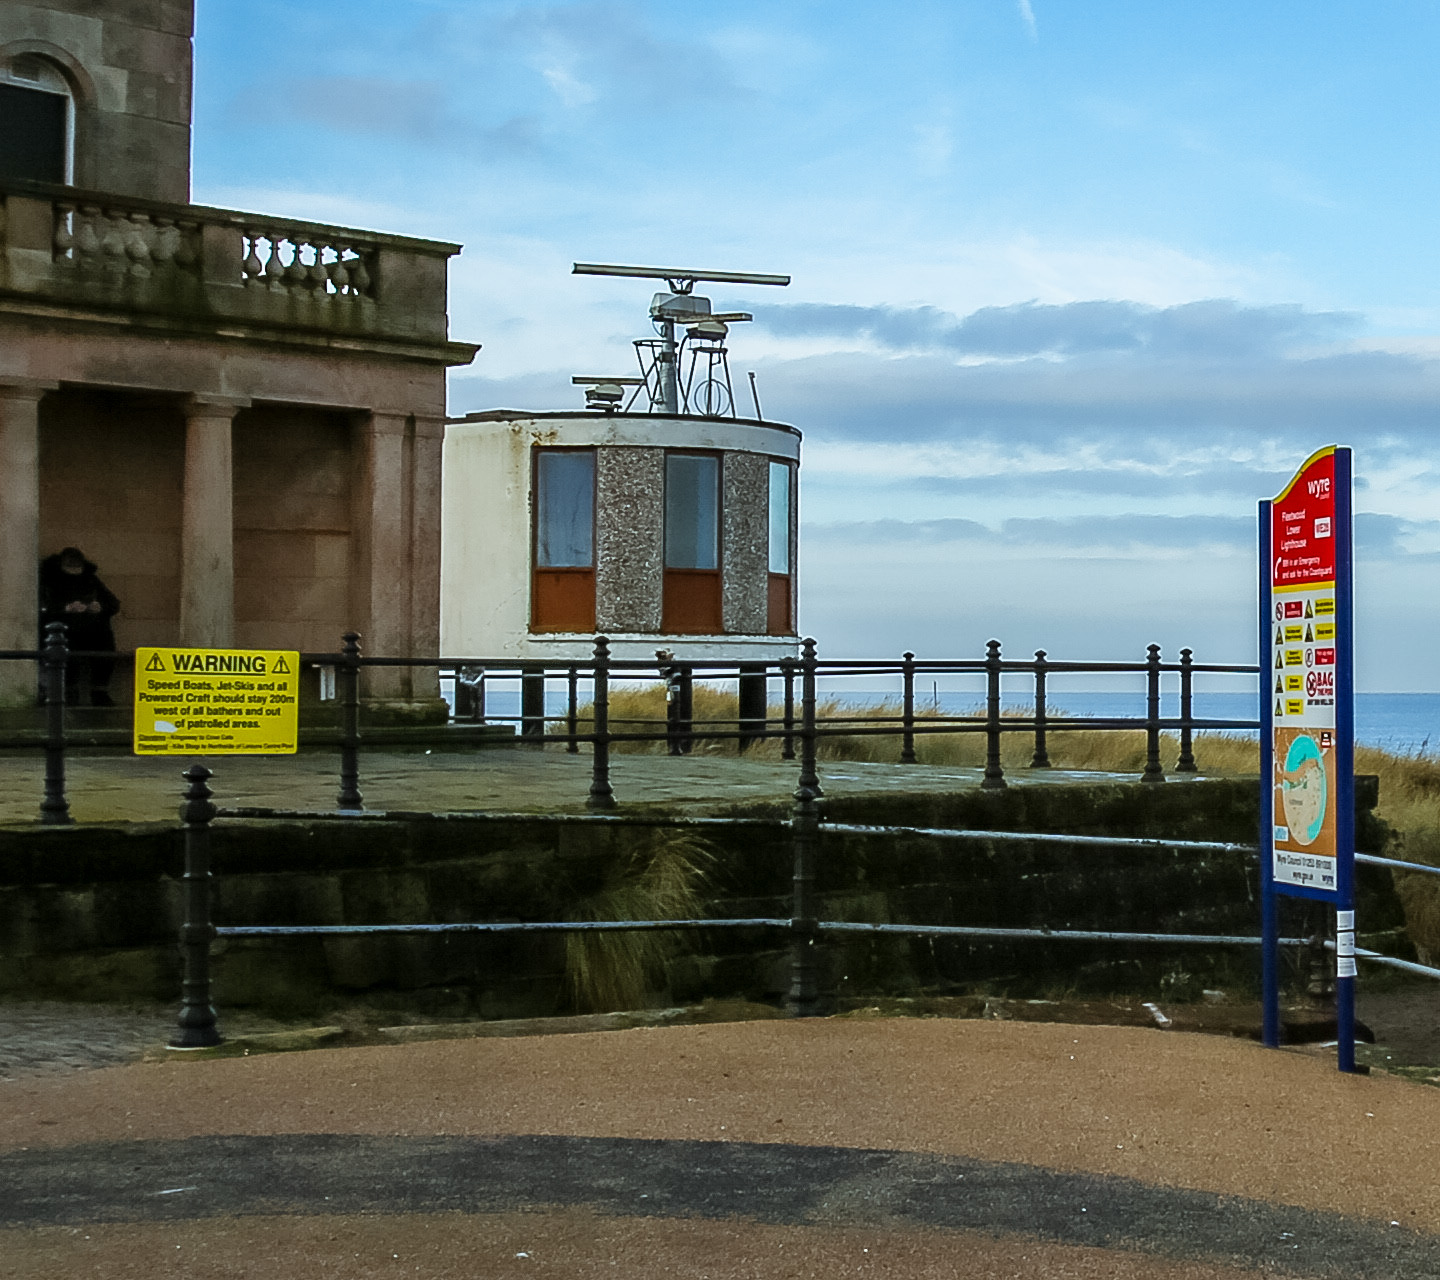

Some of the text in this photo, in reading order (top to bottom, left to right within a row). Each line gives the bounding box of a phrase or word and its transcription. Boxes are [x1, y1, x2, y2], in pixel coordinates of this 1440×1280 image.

[1308, 478, 1330, 498] wyre
[172, 654, 266, 673] WARNING
[148, 680, 288, 691] Speed Boats, Jet-Skis and all
[1317, 672, 1333, 686] BAG
[139, 692, 295, 705] Powered Craft should stay 200m
[154, 706, 282, 716] west of all bathers and out
[174, 719, 185, 728] of
[188, 720, 230, 730] patrolled
